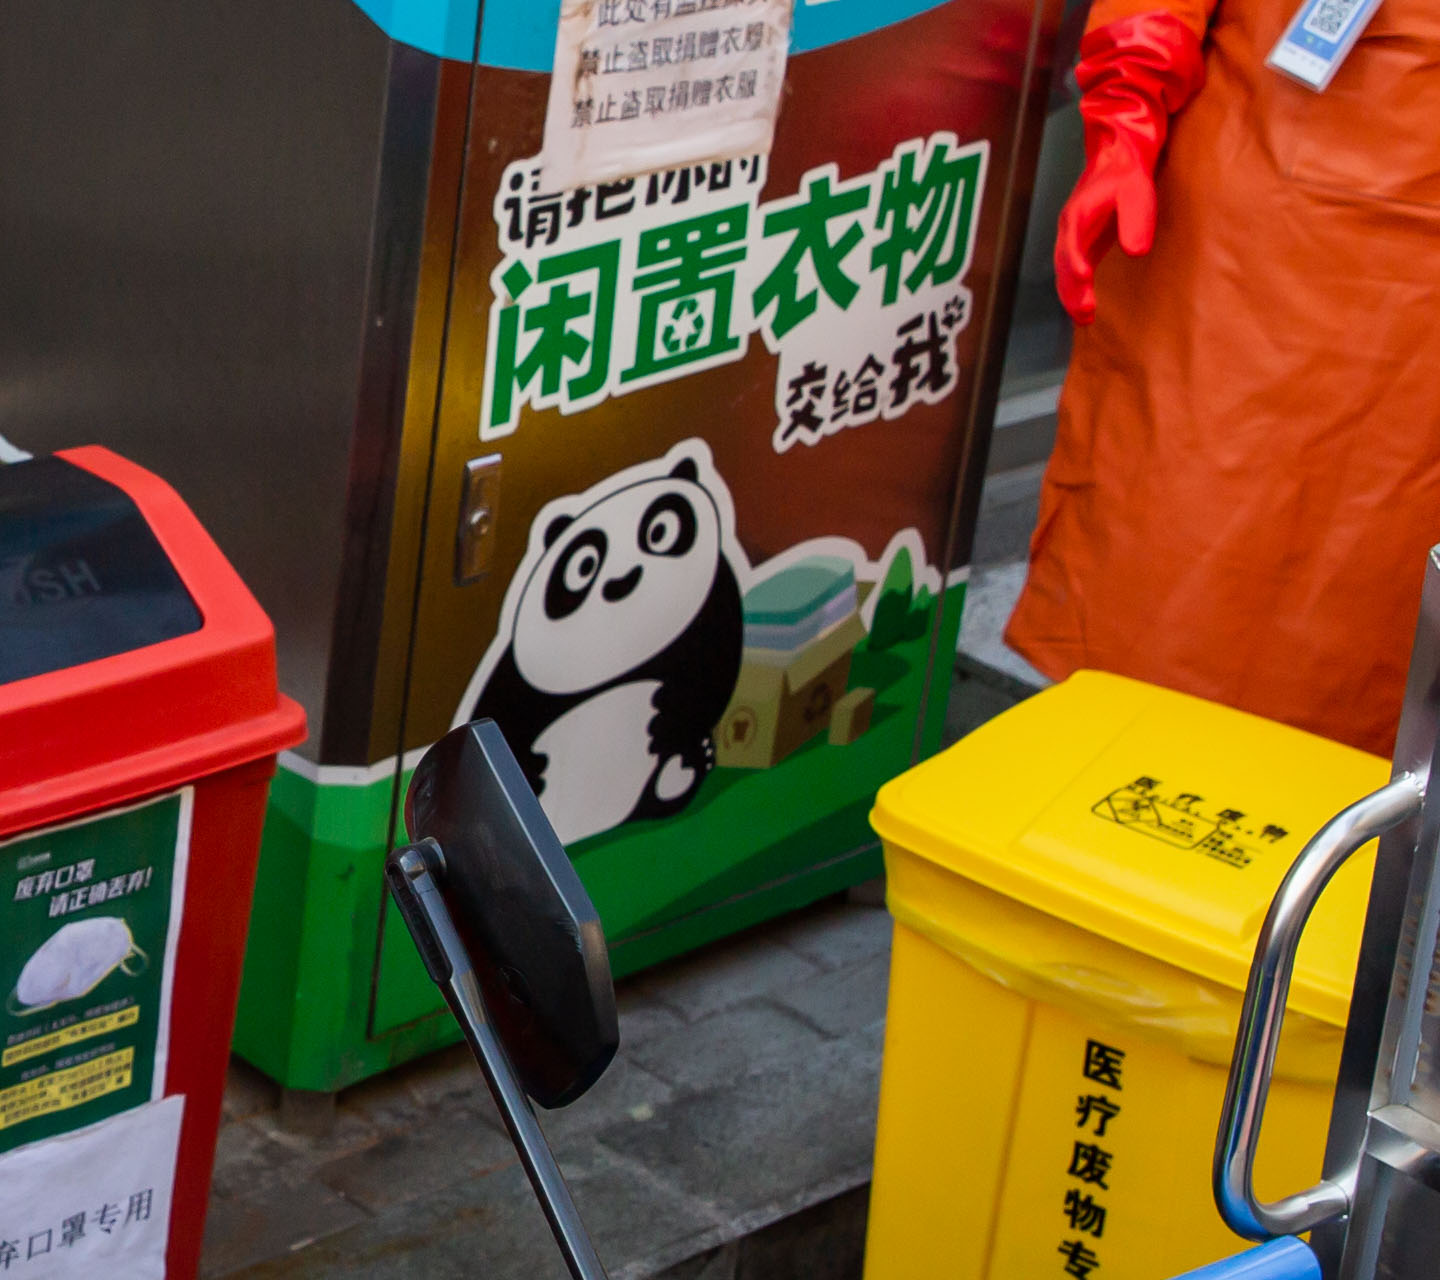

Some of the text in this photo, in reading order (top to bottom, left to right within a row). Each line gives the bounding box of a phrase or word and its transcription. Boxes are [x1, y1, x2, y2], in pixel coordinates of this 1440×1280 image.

[570, 69, 759, 129] 禁止盗取捐赠衣服
[579, 21, 766, 78] 禁止盗取捐赠衣服
[488, 143, 982, 429] 闲置衣物
[780, 296, 965, 442] 交给我
